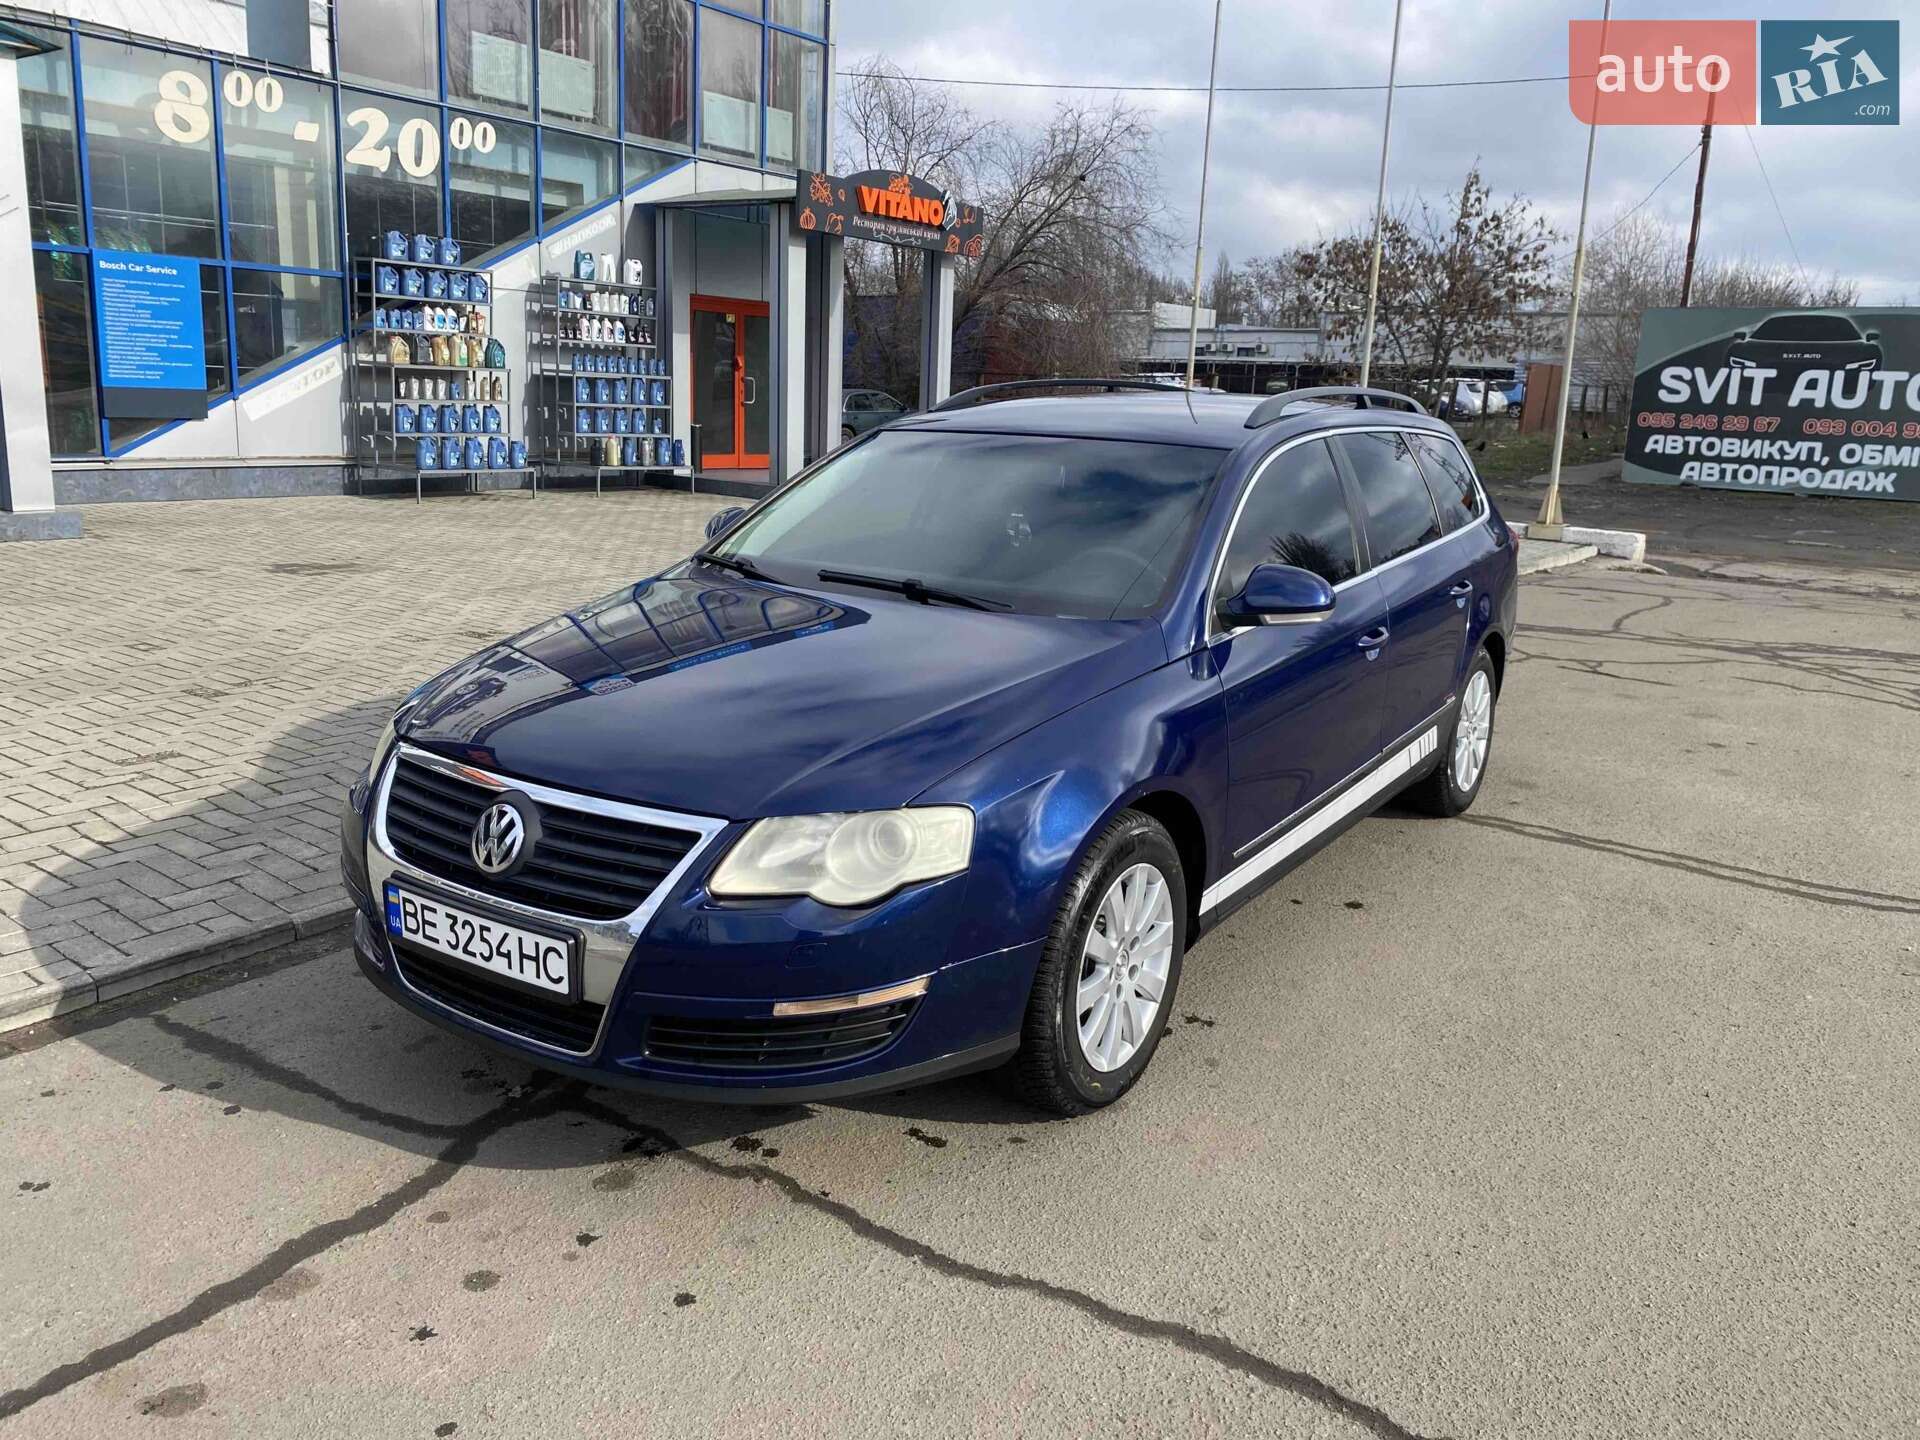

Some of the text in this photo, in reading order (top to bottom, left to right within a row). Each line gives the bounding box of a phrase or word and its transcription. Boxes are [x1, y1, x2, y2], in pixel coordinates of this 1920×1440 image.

[857, 184, 944, 226] VITANO
[99, 260, 178, 276] Bosch Car Service
[1679, 413, 1718, 431] 246
[1851, 420, 1898, 438] 004
[1902, 422, 1920, 439] 9
[1644, 434, 1829, 466] АВТОВИКУП,
[1679, 460, 1898, 493] АВТОПРОДАЖ
[390, 914, 402, 929] UA
